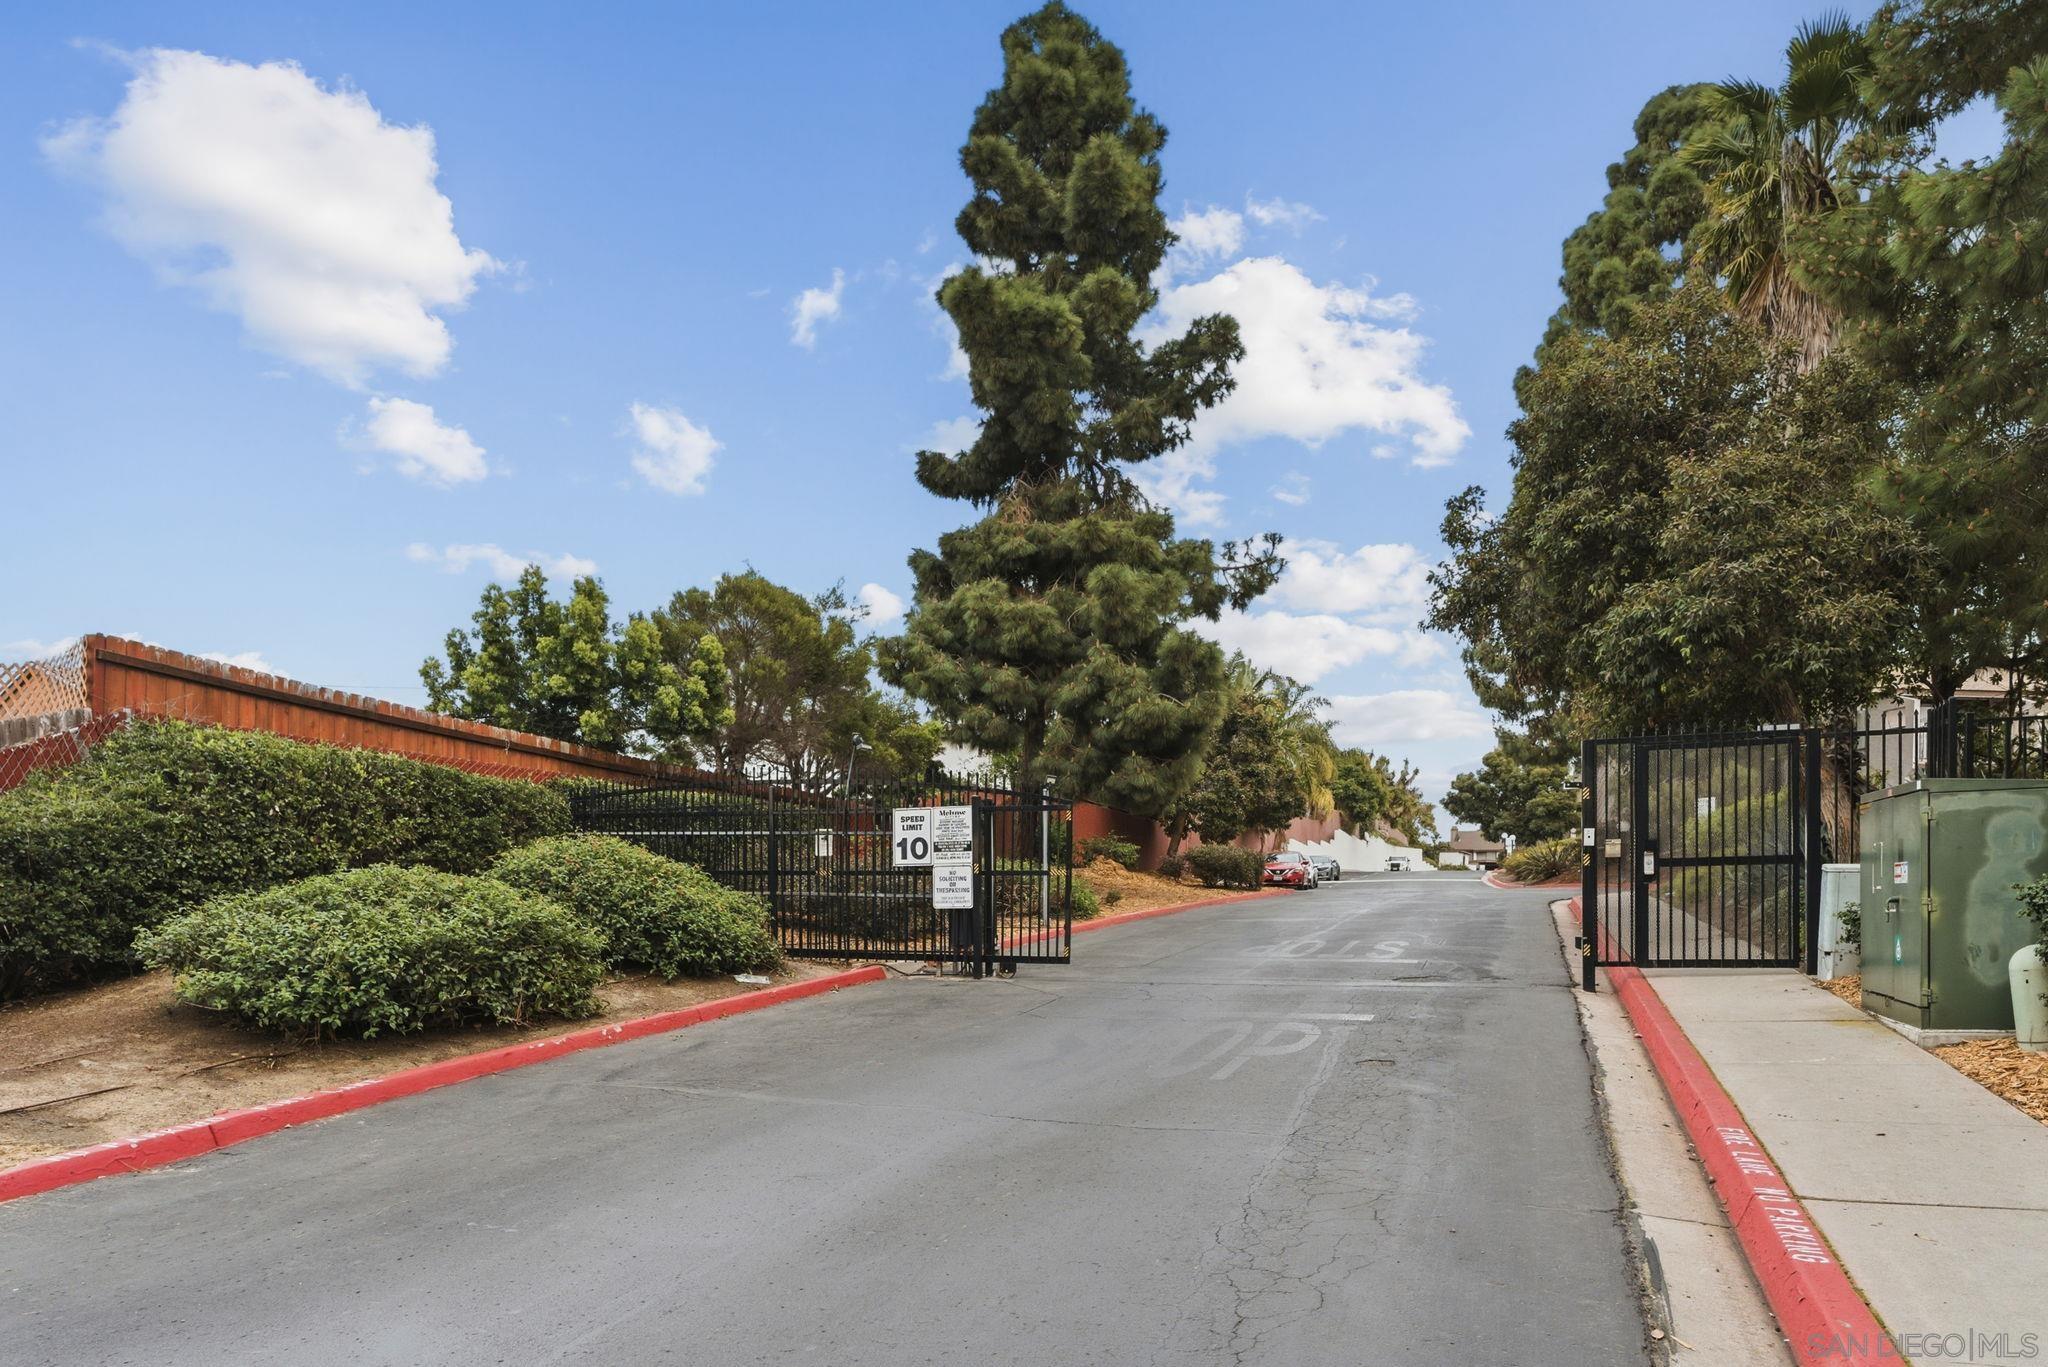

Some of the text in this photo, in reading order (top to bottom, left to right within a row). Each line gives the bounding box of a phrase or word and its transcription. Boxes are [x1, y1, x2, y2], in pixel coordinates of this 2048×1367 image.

[896, 837, 929, 860] 10
[1716, 1127, 1831, 1264] FIRE LANE NO PARKING
